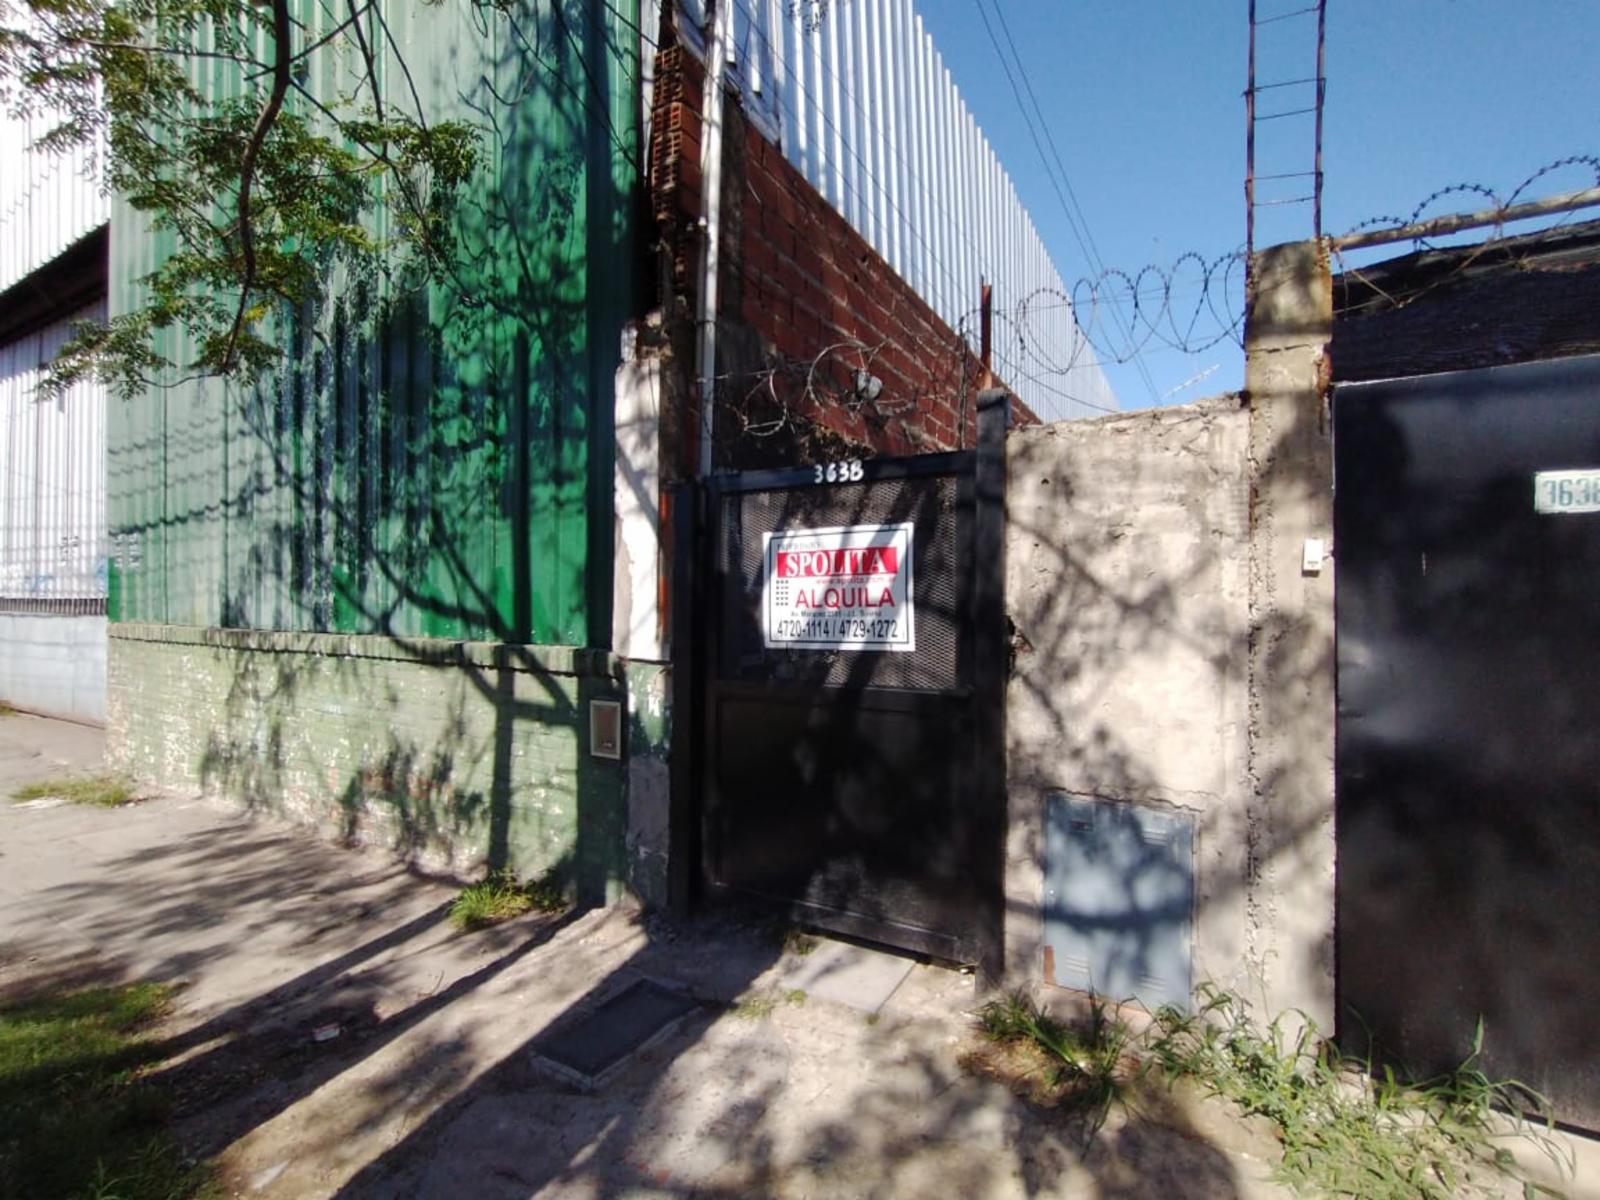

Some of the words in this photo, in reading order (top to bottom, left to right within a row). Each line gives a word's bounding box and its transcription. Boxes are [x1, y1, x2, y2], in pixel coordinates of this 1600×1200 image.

[814, 460, 864, 483] 3638
[785, 549, 888, 577] SPOLITA
[795, 587, 896, 609] ALQUILA
